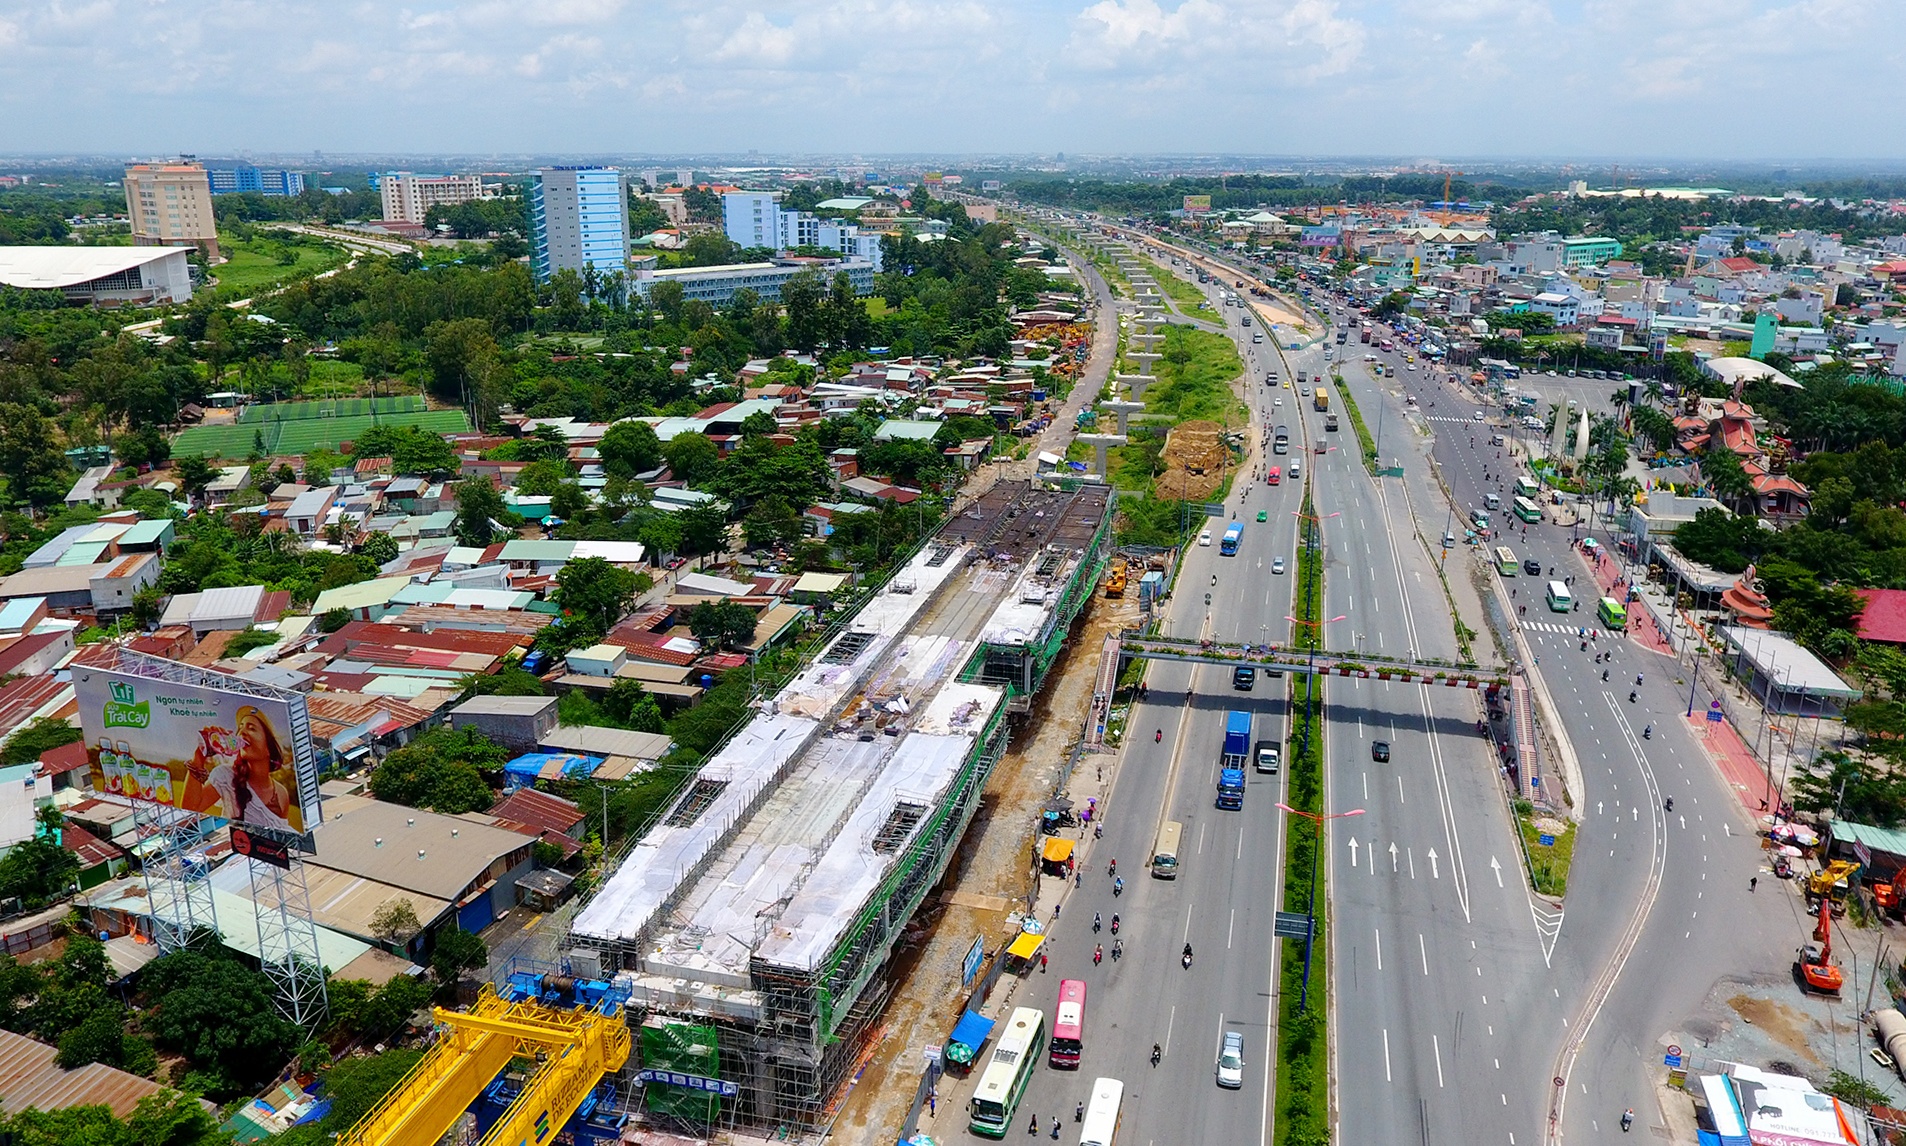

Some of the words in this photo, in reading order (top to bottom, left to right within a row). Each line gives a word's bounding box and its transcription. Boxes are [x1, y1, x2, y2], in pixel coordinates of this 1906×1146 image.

[155, 695, 178, 706] Ngon
[551, 1058, 588, 1111] RIZZANI
[552, 1102, 566, 1124] DE
[565, 1060, 599, 1109] ECCHER
[1769, 1123, 1800, 1133] HOTLINE
